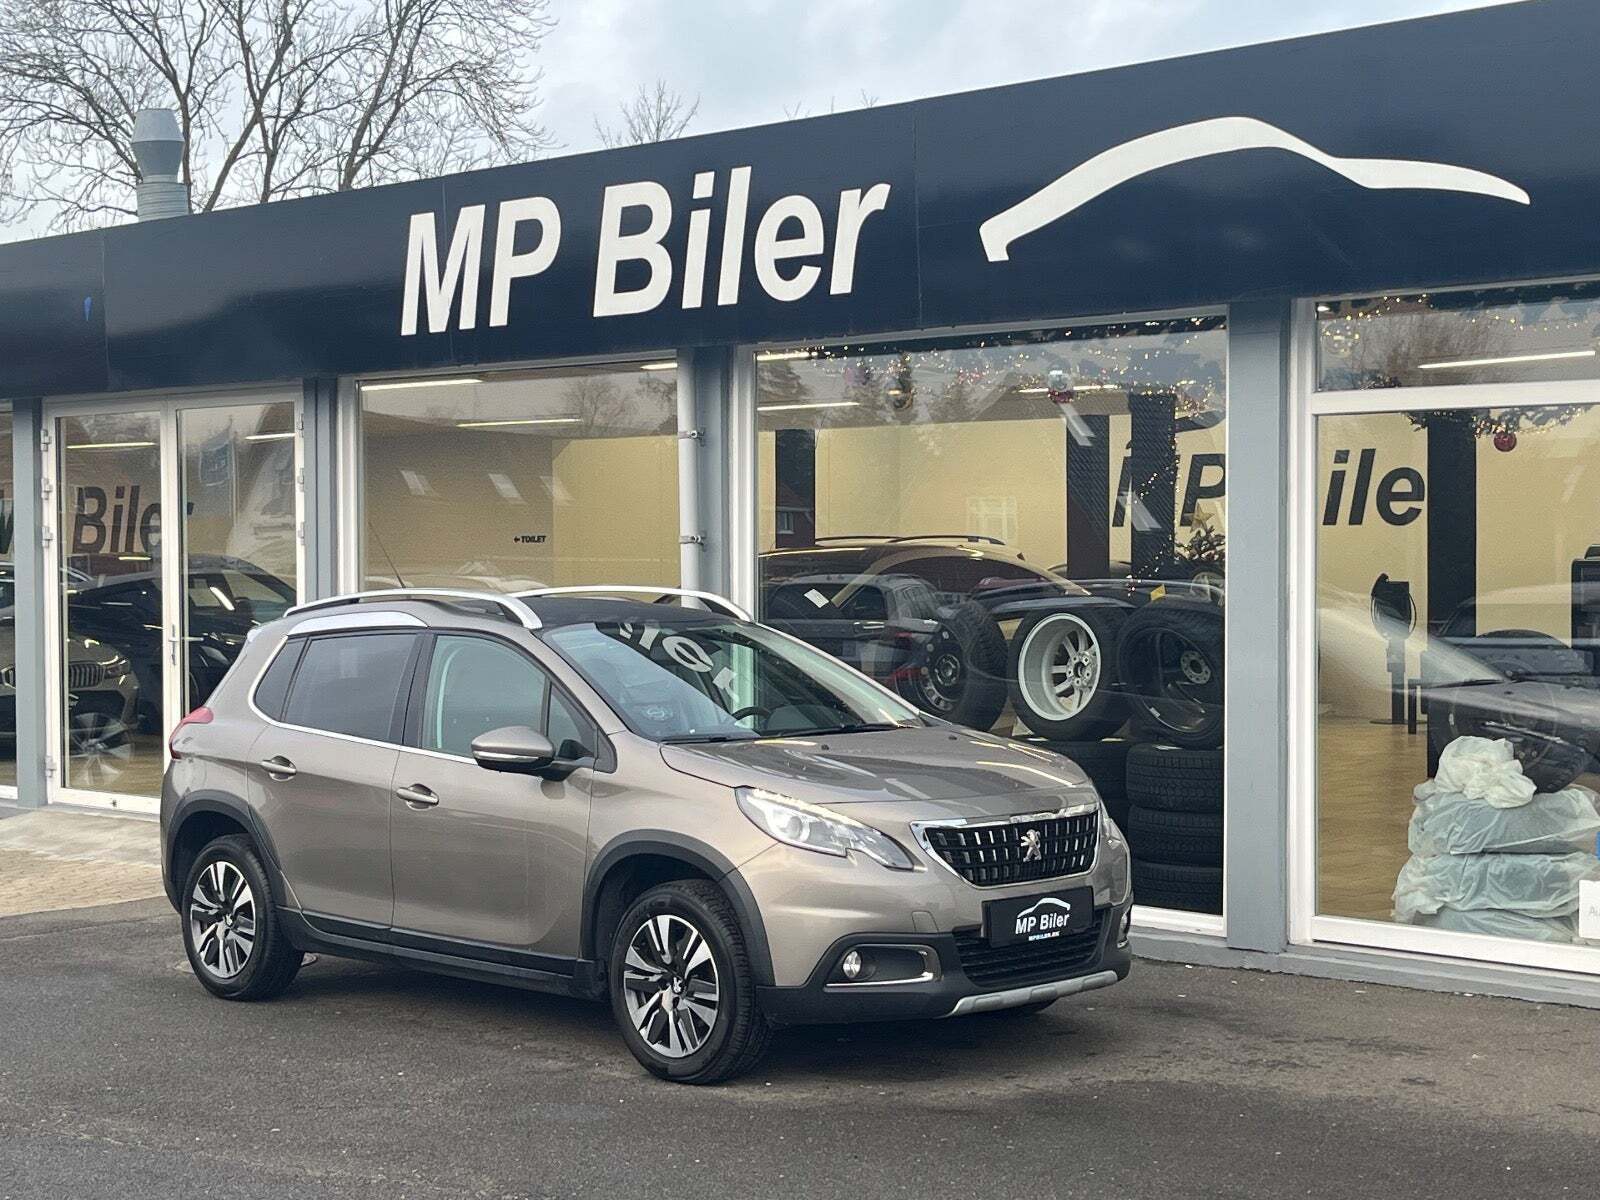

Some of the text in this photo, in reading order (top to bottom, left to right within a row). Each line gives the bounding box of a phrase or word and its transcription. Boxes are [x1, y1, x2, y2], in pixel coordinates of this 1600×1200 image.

[400, 165, 892, 336] MP Biler
[72, 485, 194, 554] Bile
[1322, 448, 1426, 526] ile
[521, 535, 547, 544] TOILET
[1015, 912, 1070, 935] MP Biler
